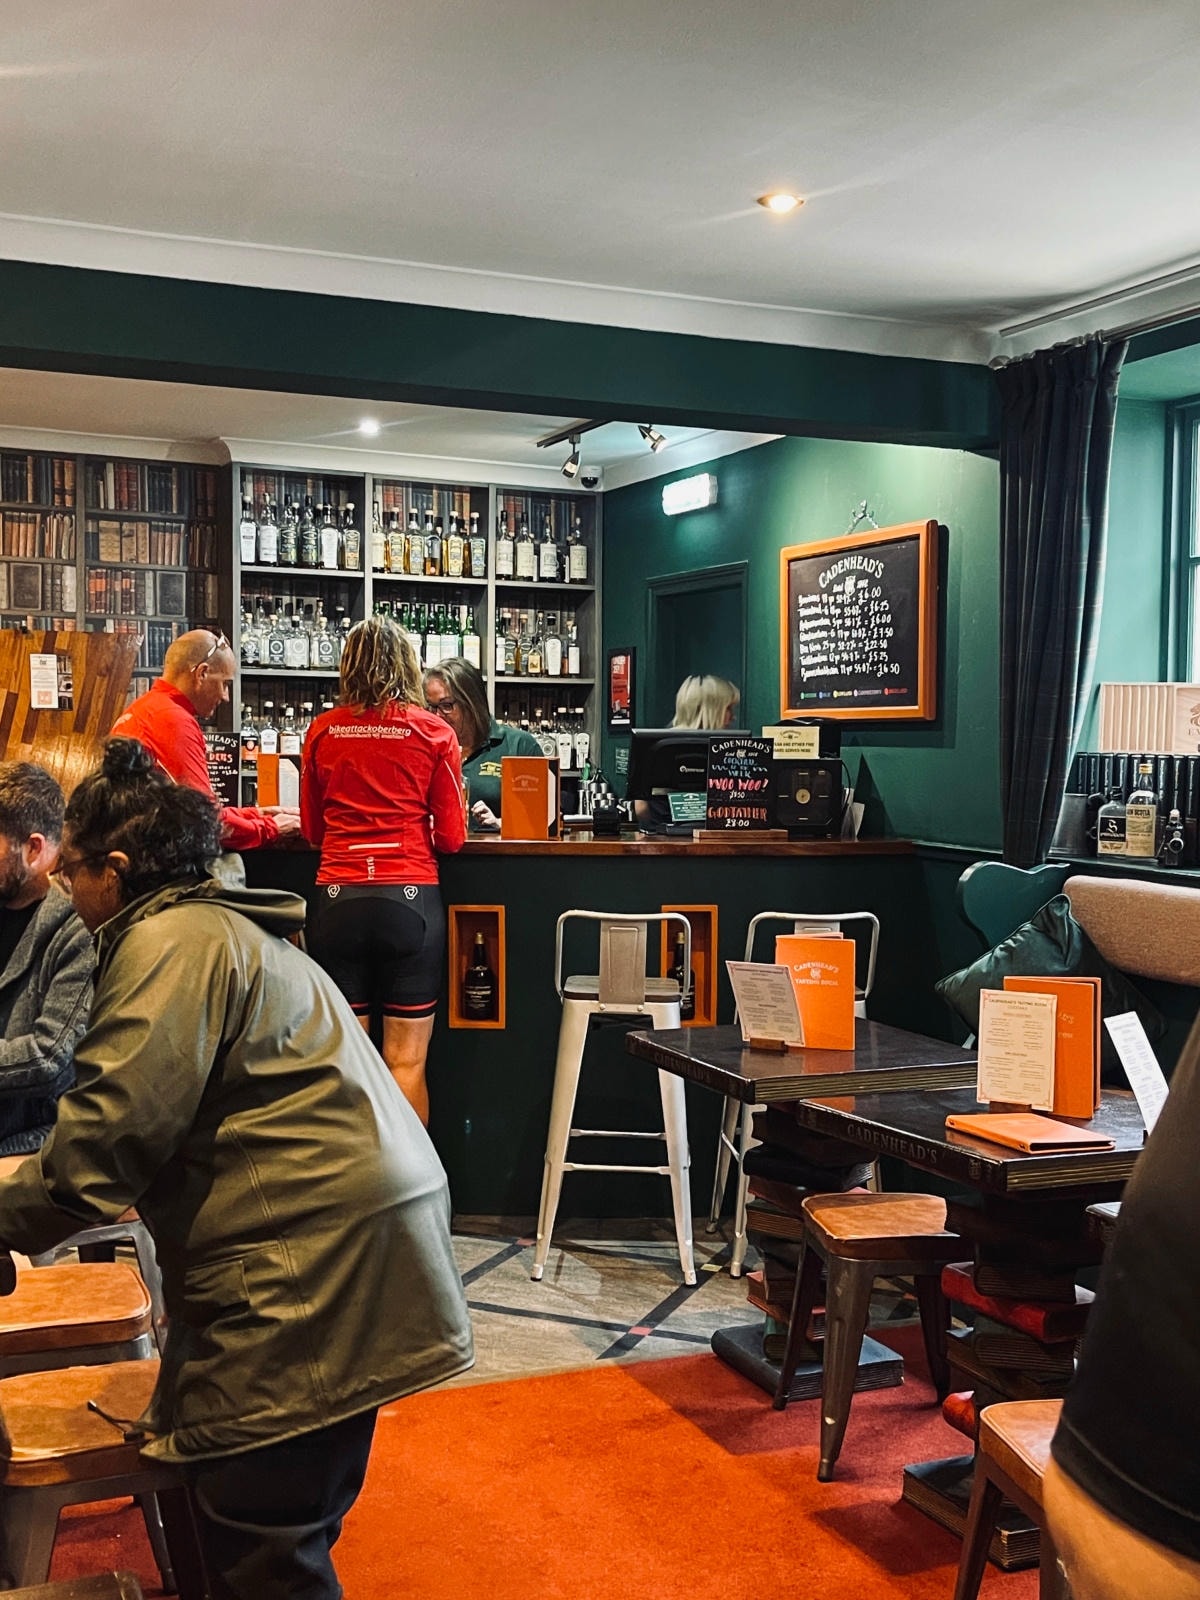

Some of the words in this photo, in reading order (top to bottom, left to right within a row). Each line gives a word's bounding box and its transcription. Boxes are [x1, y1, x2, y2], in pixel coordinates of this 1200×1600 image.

[818, 555, 884, 588] CADENHEAD'S
[711, 739, 771, 753] CADENHEAD'S
[793, 961, 839, 974] CADENHEAD'S
[847, 1123, 937, 1164] CADENHEAD'S
